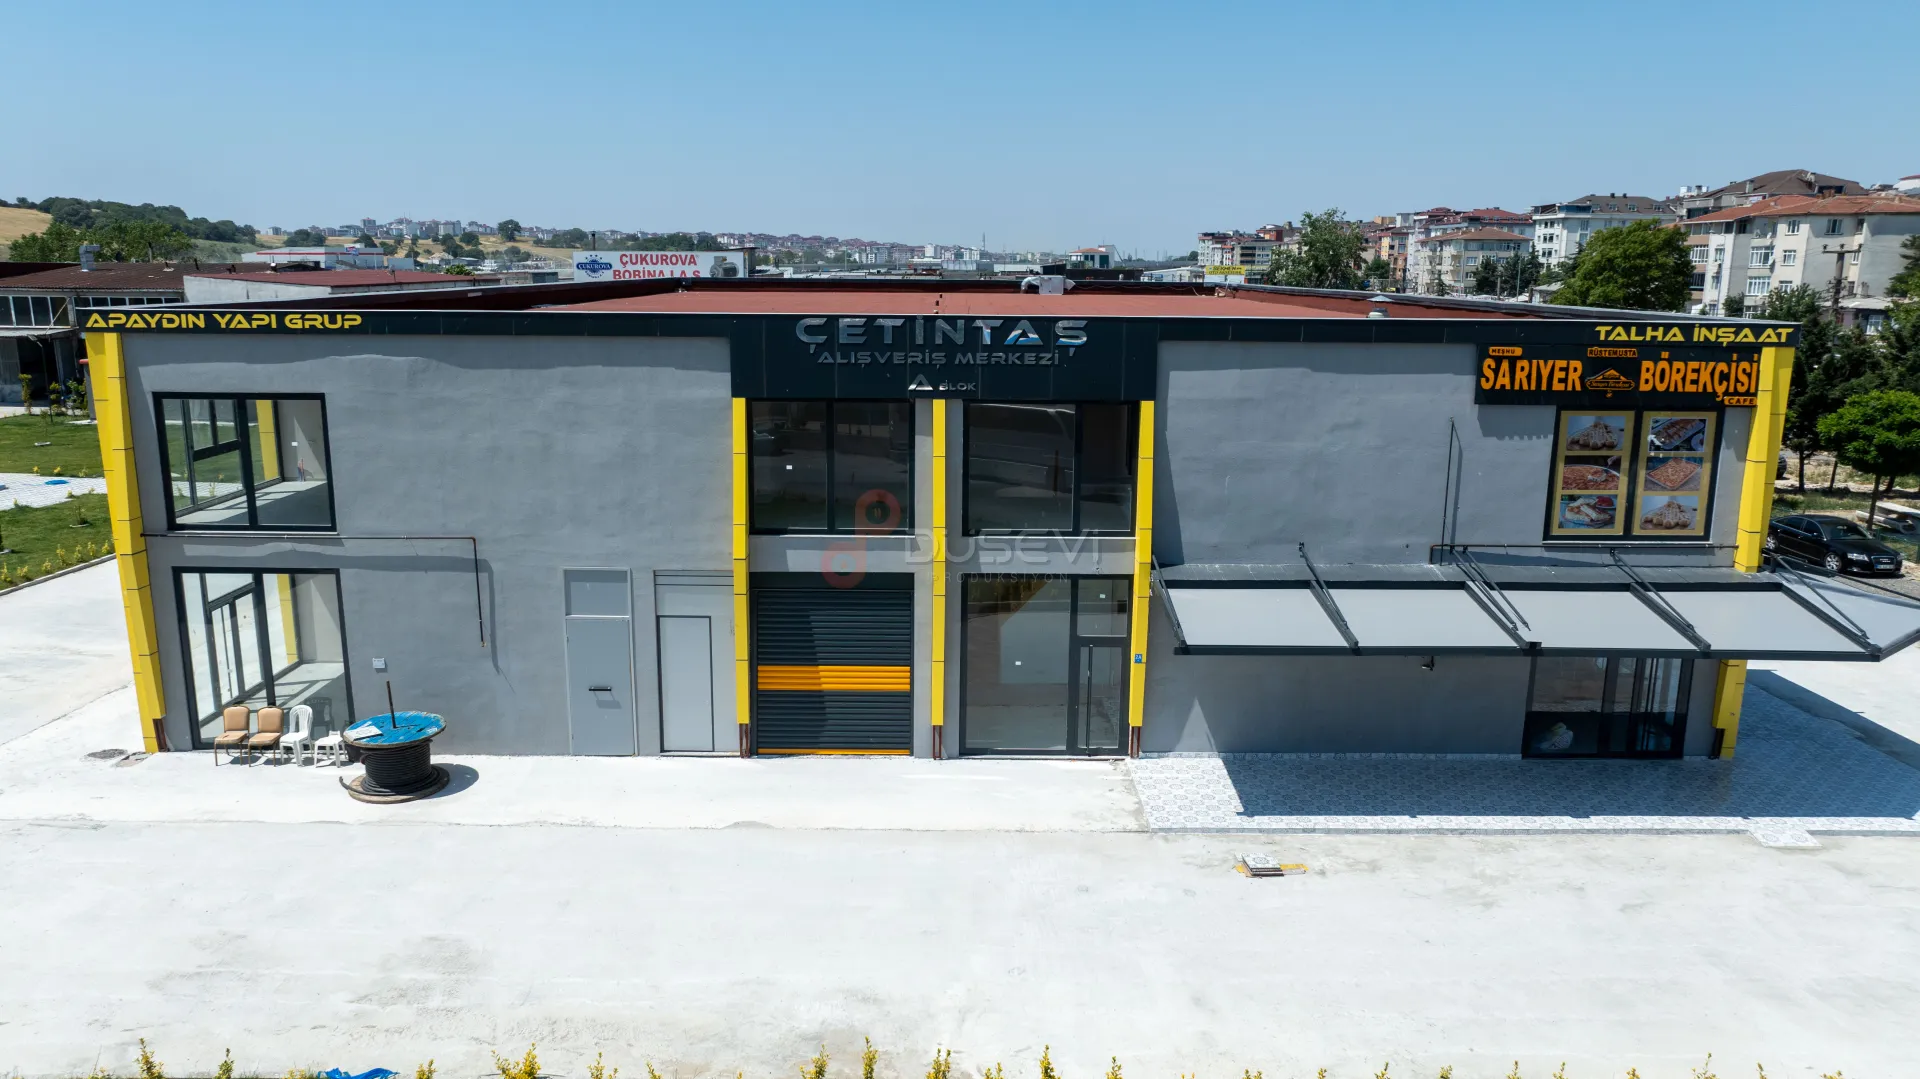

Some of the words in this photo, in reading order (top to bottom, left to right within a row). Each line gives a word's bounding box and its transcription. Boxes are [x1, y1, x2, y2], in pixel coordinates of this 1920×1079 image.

[619, 253, 698, 268] ÇUKUROVA
[85, 313, 205, 328] APAYDIN
[212, 313, 277, 329] YAPI
[284, 313, 362, 329] GRUP
[795, 315, 1089, 357] ÇETİNTAŞ
[1595, 325, 1686, 342] TALHA
[1692, 323, 1795, 347] İNŞAAT
[817, 349, 947, 369] ALIŞVERİŞ
[954, 350, 1060, 365] MERKEZİ
[1481, 358, 1583, 392] SARIYER
[1638, 351, 1759, 402] BÖREKÇİSİ
[938, 382, 977, 391] BLOK
